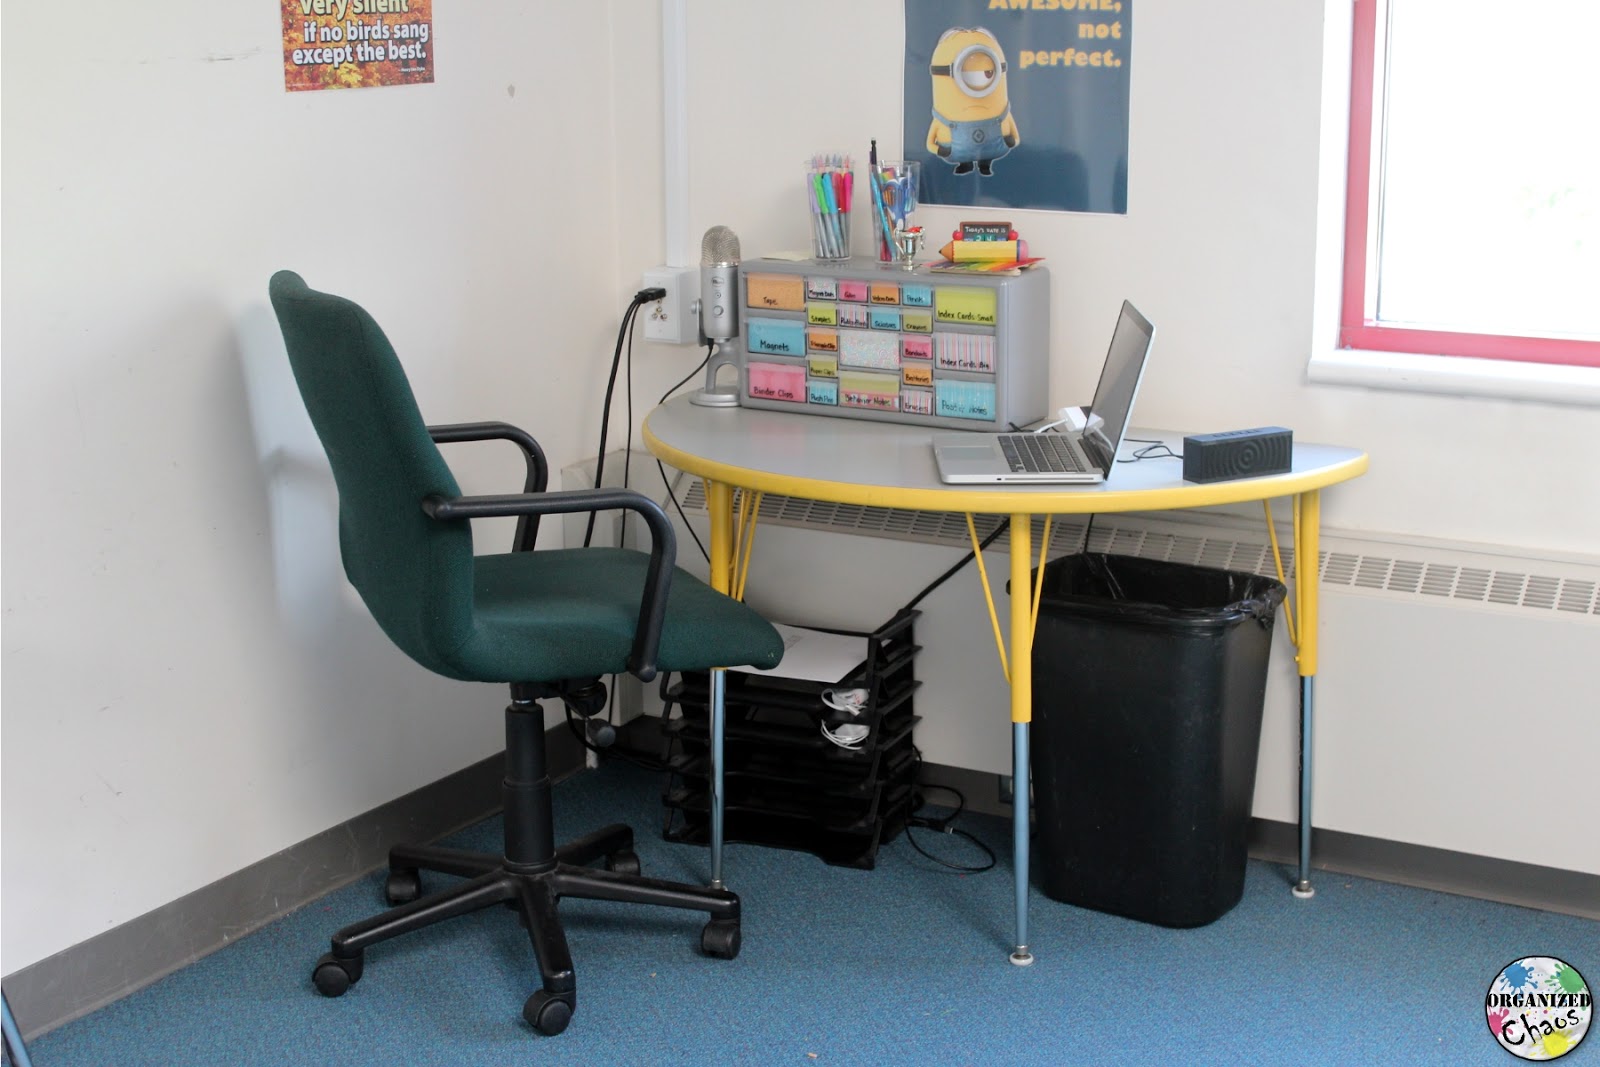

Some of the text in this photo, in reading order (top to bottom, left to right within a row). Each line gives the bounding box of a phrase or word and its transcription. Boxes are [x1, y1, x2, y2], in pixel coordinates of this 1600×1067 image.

[303, 19, 429, 43] if no birds sang
[1078, 21, 1122, 39] not
[292, 39, 427, 69] except the best.
[1019, 47, 1122, 69] perfect.
[762, 296, 779, 306] Tape
[937, 309, 994, 323] Index Cards Small
[760, 339, 790, 352] Magnets
[940, 357, 957, 366] Index
[958, 359, 976, 369] Cards
[906, 373, 929, 383] Batteries
[753, 386, 795, 399] Binder Clips
